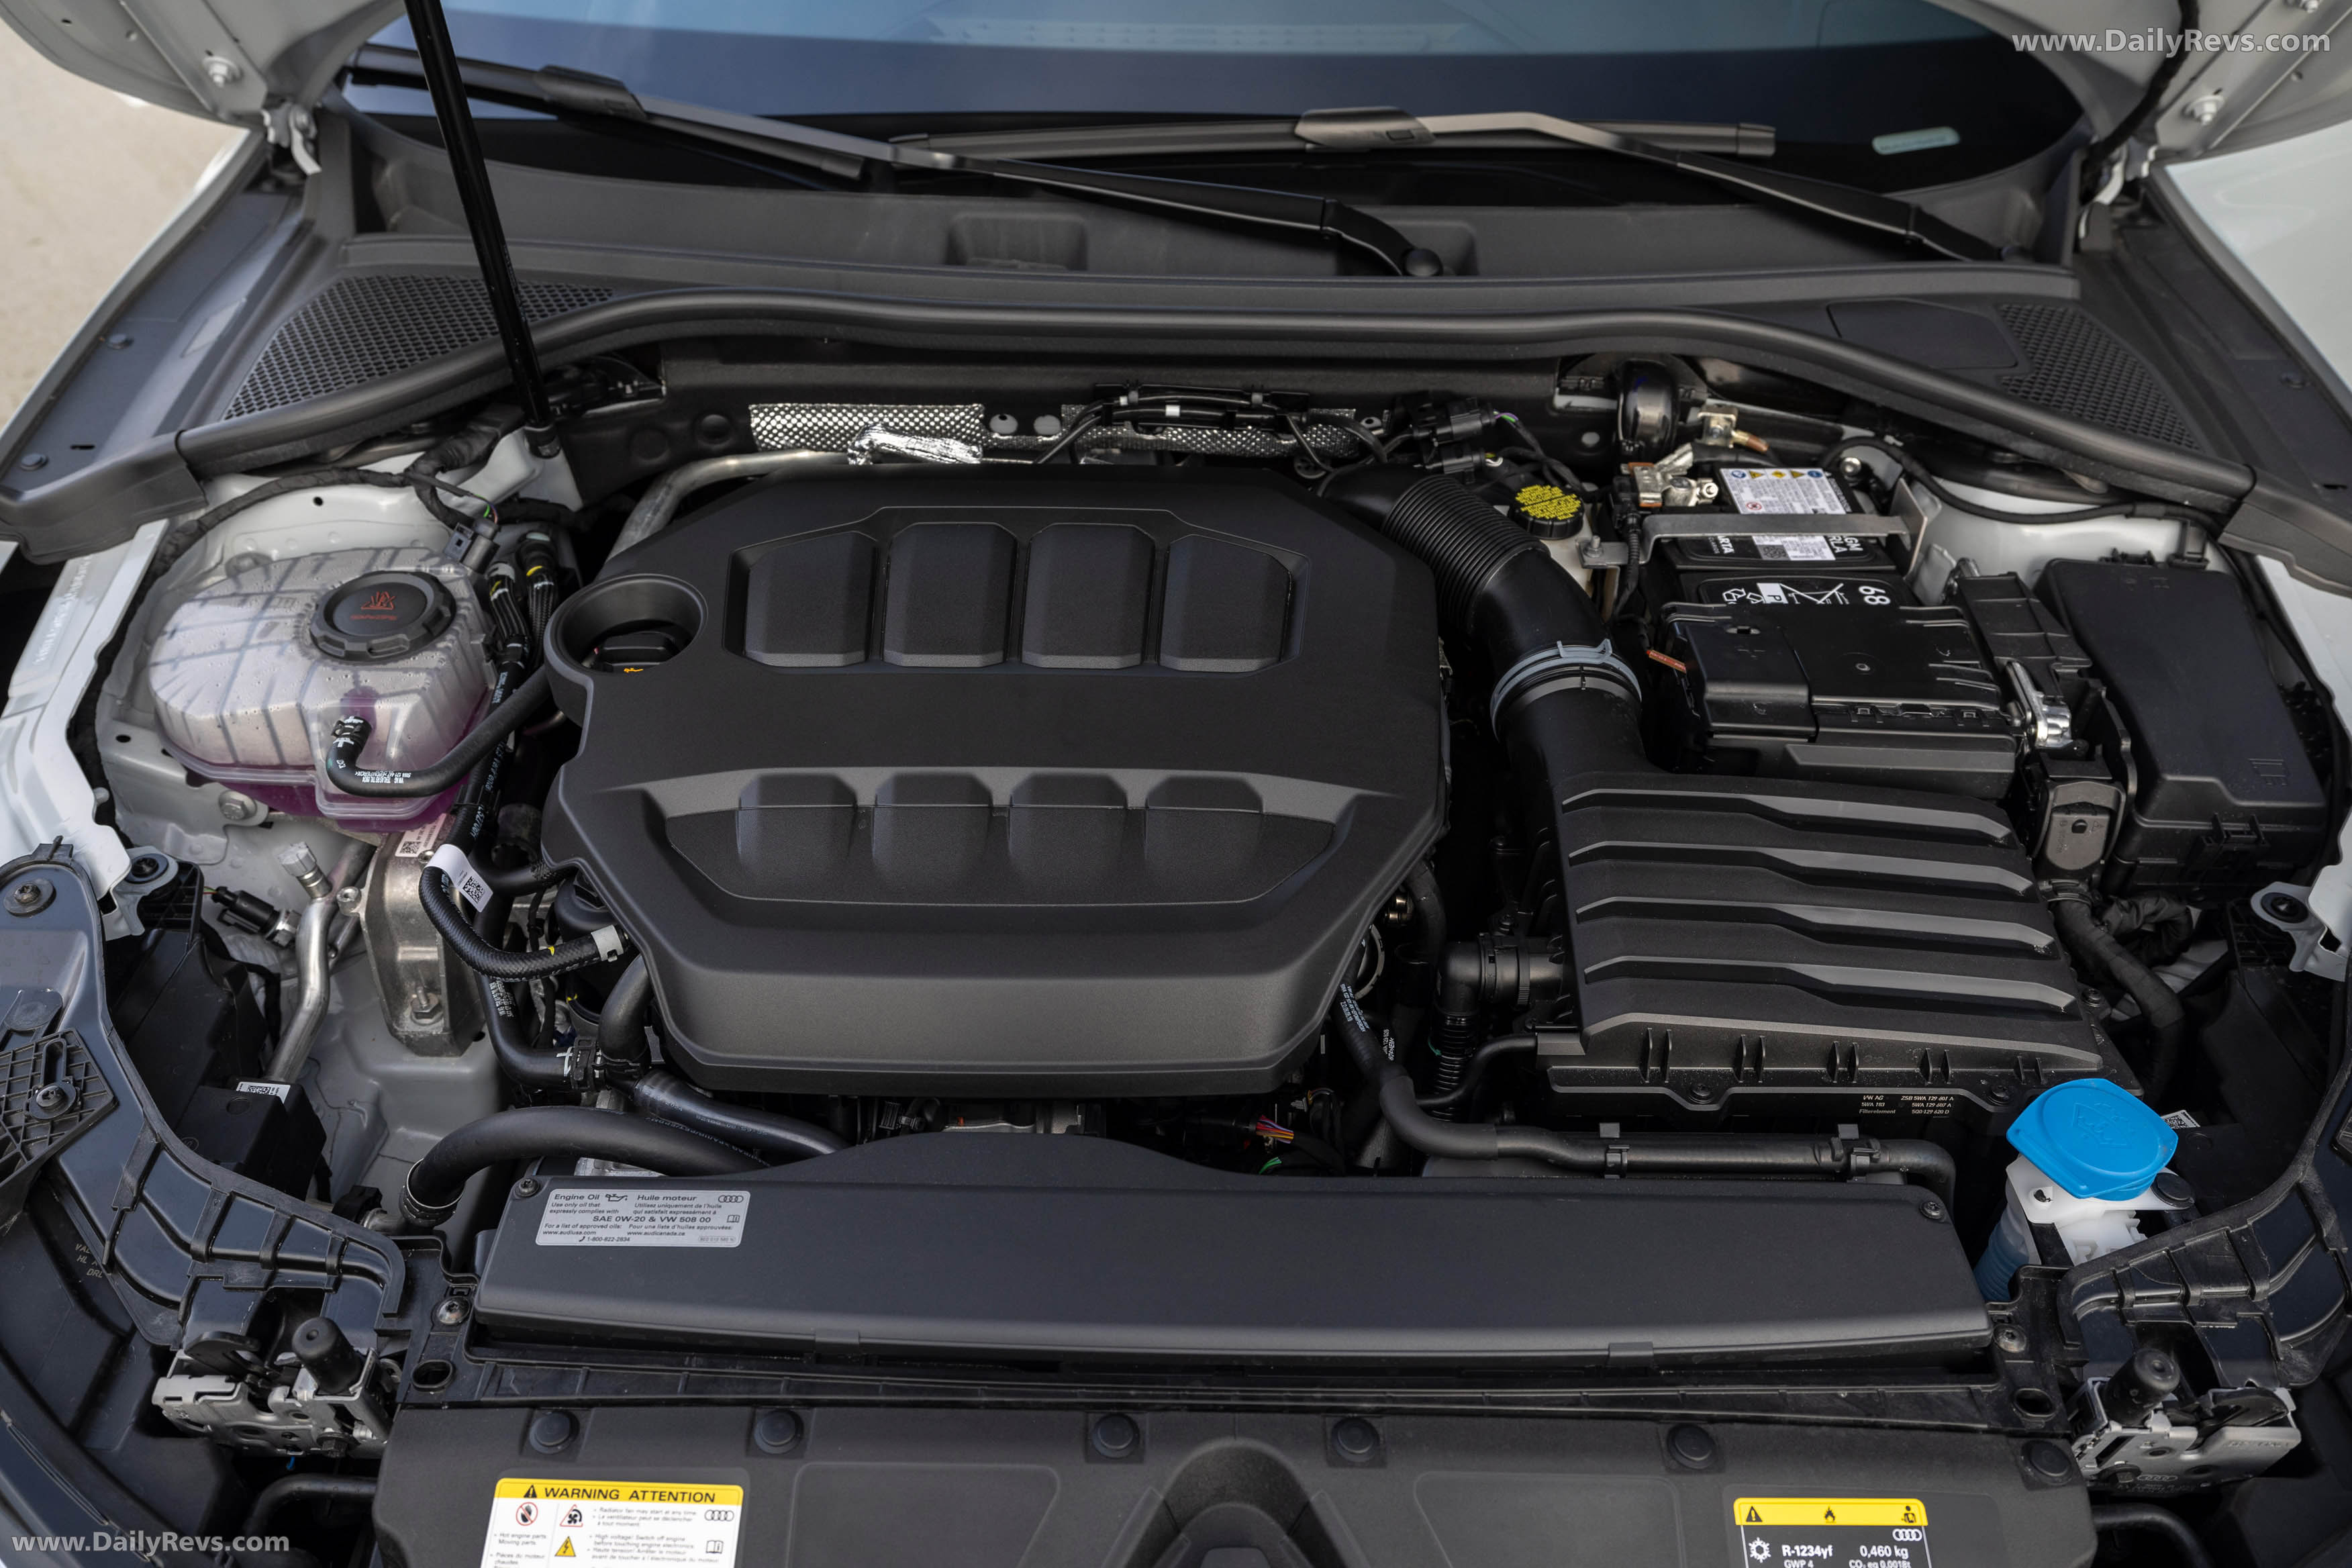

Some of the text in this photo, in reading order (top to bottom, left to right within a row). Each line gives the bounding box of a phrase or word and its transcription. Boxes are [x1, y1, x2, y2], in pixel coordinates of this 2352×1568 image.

[1718, 536, 1734, 554] RTA
[1828, 536, 1847, 553] RLA
[1842, 536, 1863, 551] GM
[554, 1193, 585, 1202] Engine
[544, 1487, 716, 1503] WARNING ATTENTION
[1781, 1545, 1910, 1559] R-1234yf 0,460 kg
[1783, 1559, 1814, 1568] GWP 4
